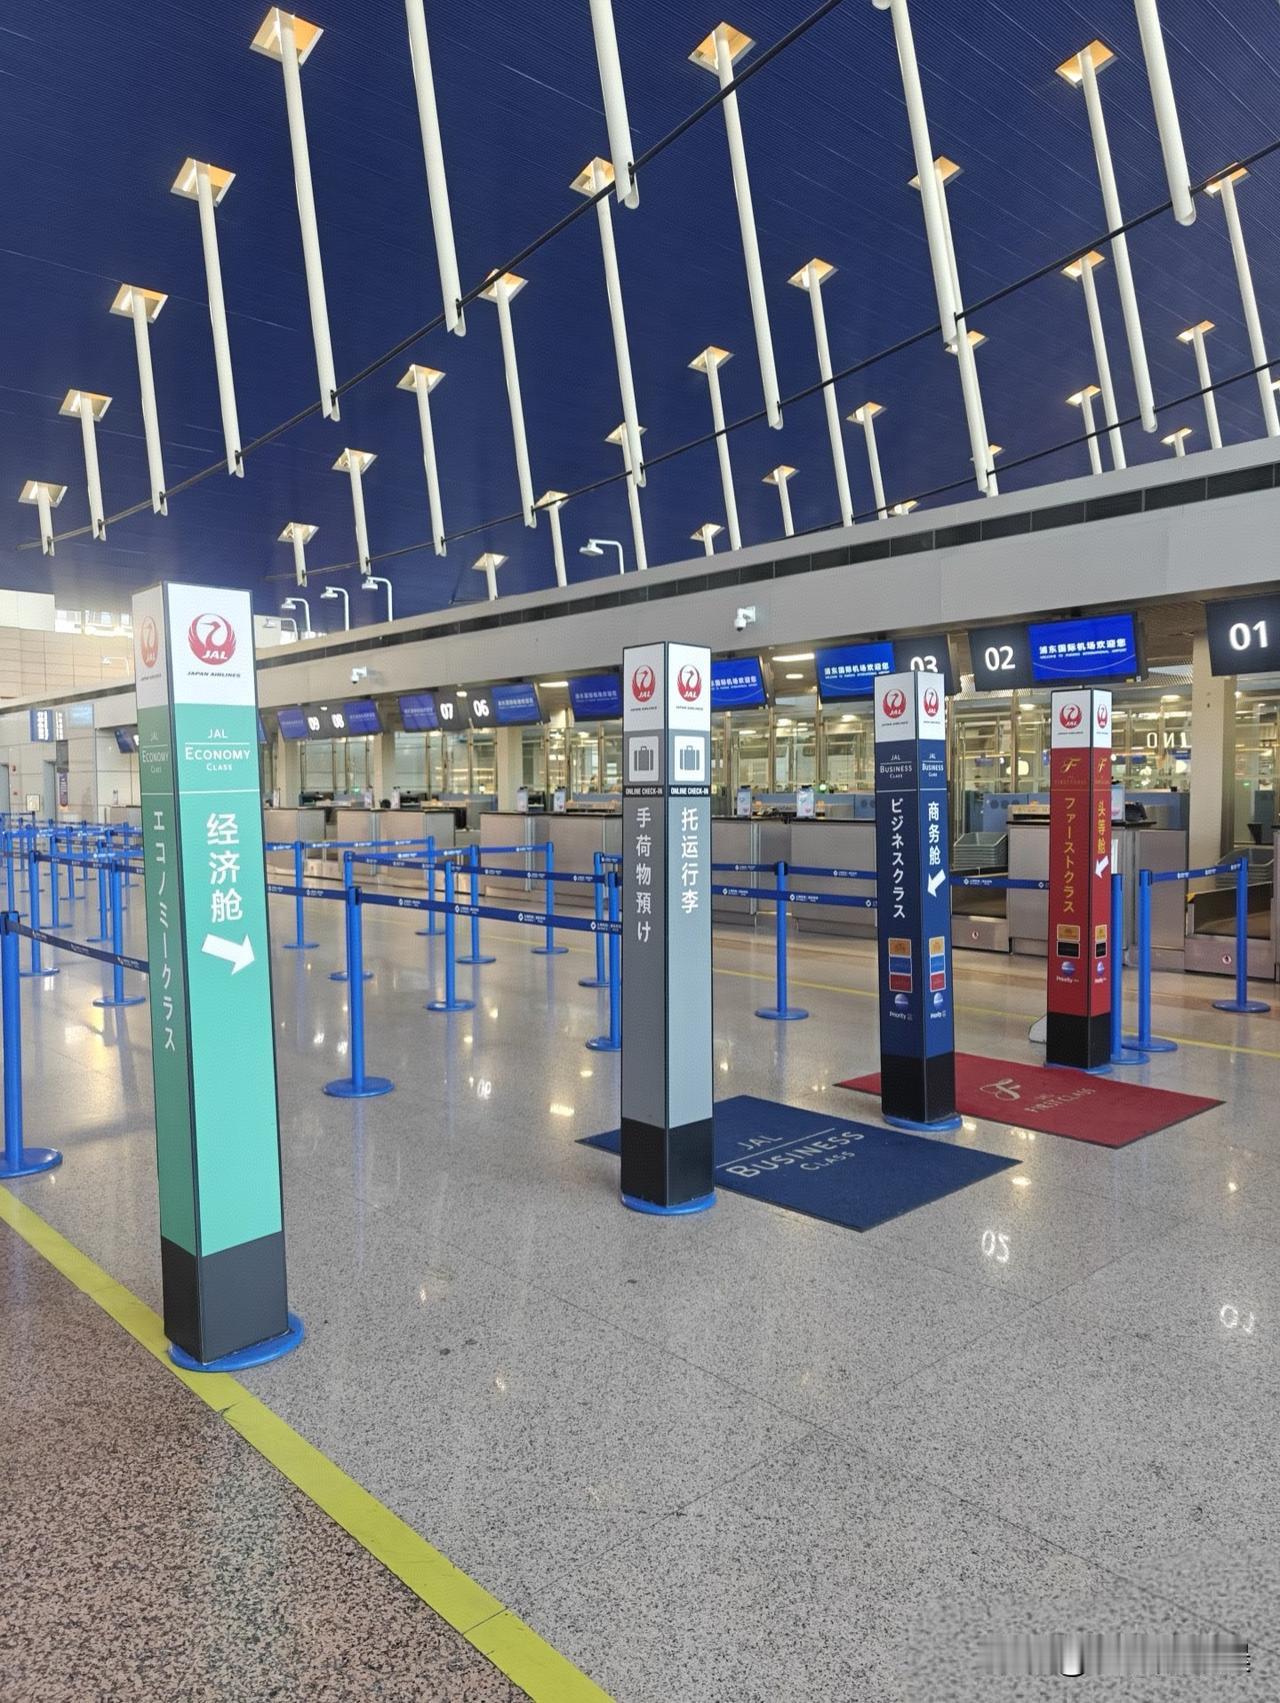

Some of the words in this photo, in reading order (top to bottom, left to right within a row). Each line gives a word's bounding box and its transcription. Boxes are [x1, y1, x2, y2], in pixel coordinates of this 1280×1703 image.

[1229, 620, 1269, 651] 01
[202, 650, 228, 660] JAL
[910, 655, 938, 673] 03
[984, 645, 1016, 672] 02
[440, 702, 454, 720] 07
[473, 699, 489, 717] 06
[207, 729, 228, 740] JAL
[185, 746, 250, 761] ECONOMY
[671, 787, 687, 795] ONLINE
[688, 787, 709, 795] CHECK-IN
[928, 801, 941, 865] 商务舱
[206, 812, 243, 923] 经济舱
[681, 807, 699, 914] 托运行李
[891, 798, 905, 919] ビジネスクラス
[1063, 797, 1076, 913] ファーストクラス
[636, 807, 652, 943] 手荷物預け
[153, 811, 176, 1051] エコノミークラス
[726, 1131, 865, 1178] BUSINESS
[737, 1134, 783, 1151] JAL
